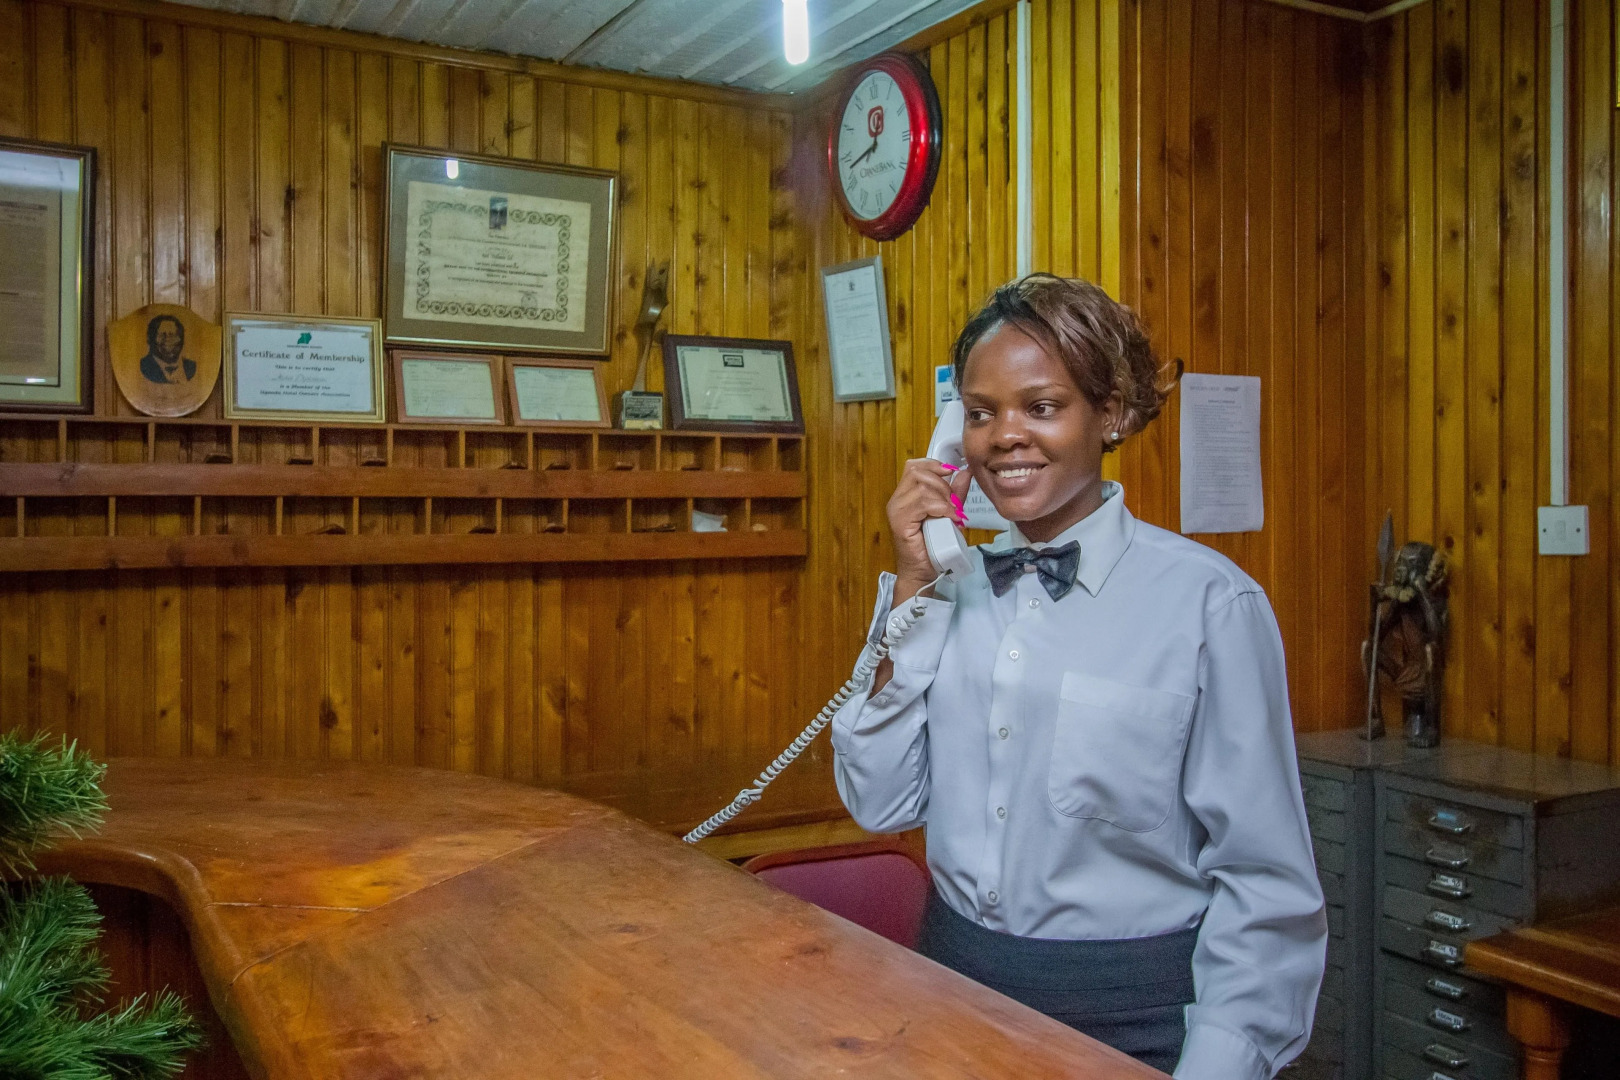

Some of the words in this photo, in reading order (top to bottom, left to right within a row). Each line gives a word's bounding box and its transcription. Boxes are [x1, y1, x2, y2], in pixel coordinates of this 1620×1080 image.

[241, 349, 291, 359] Certificate
[295, 351, 305, 360] of
[309, 352, 365, 363] Membership
